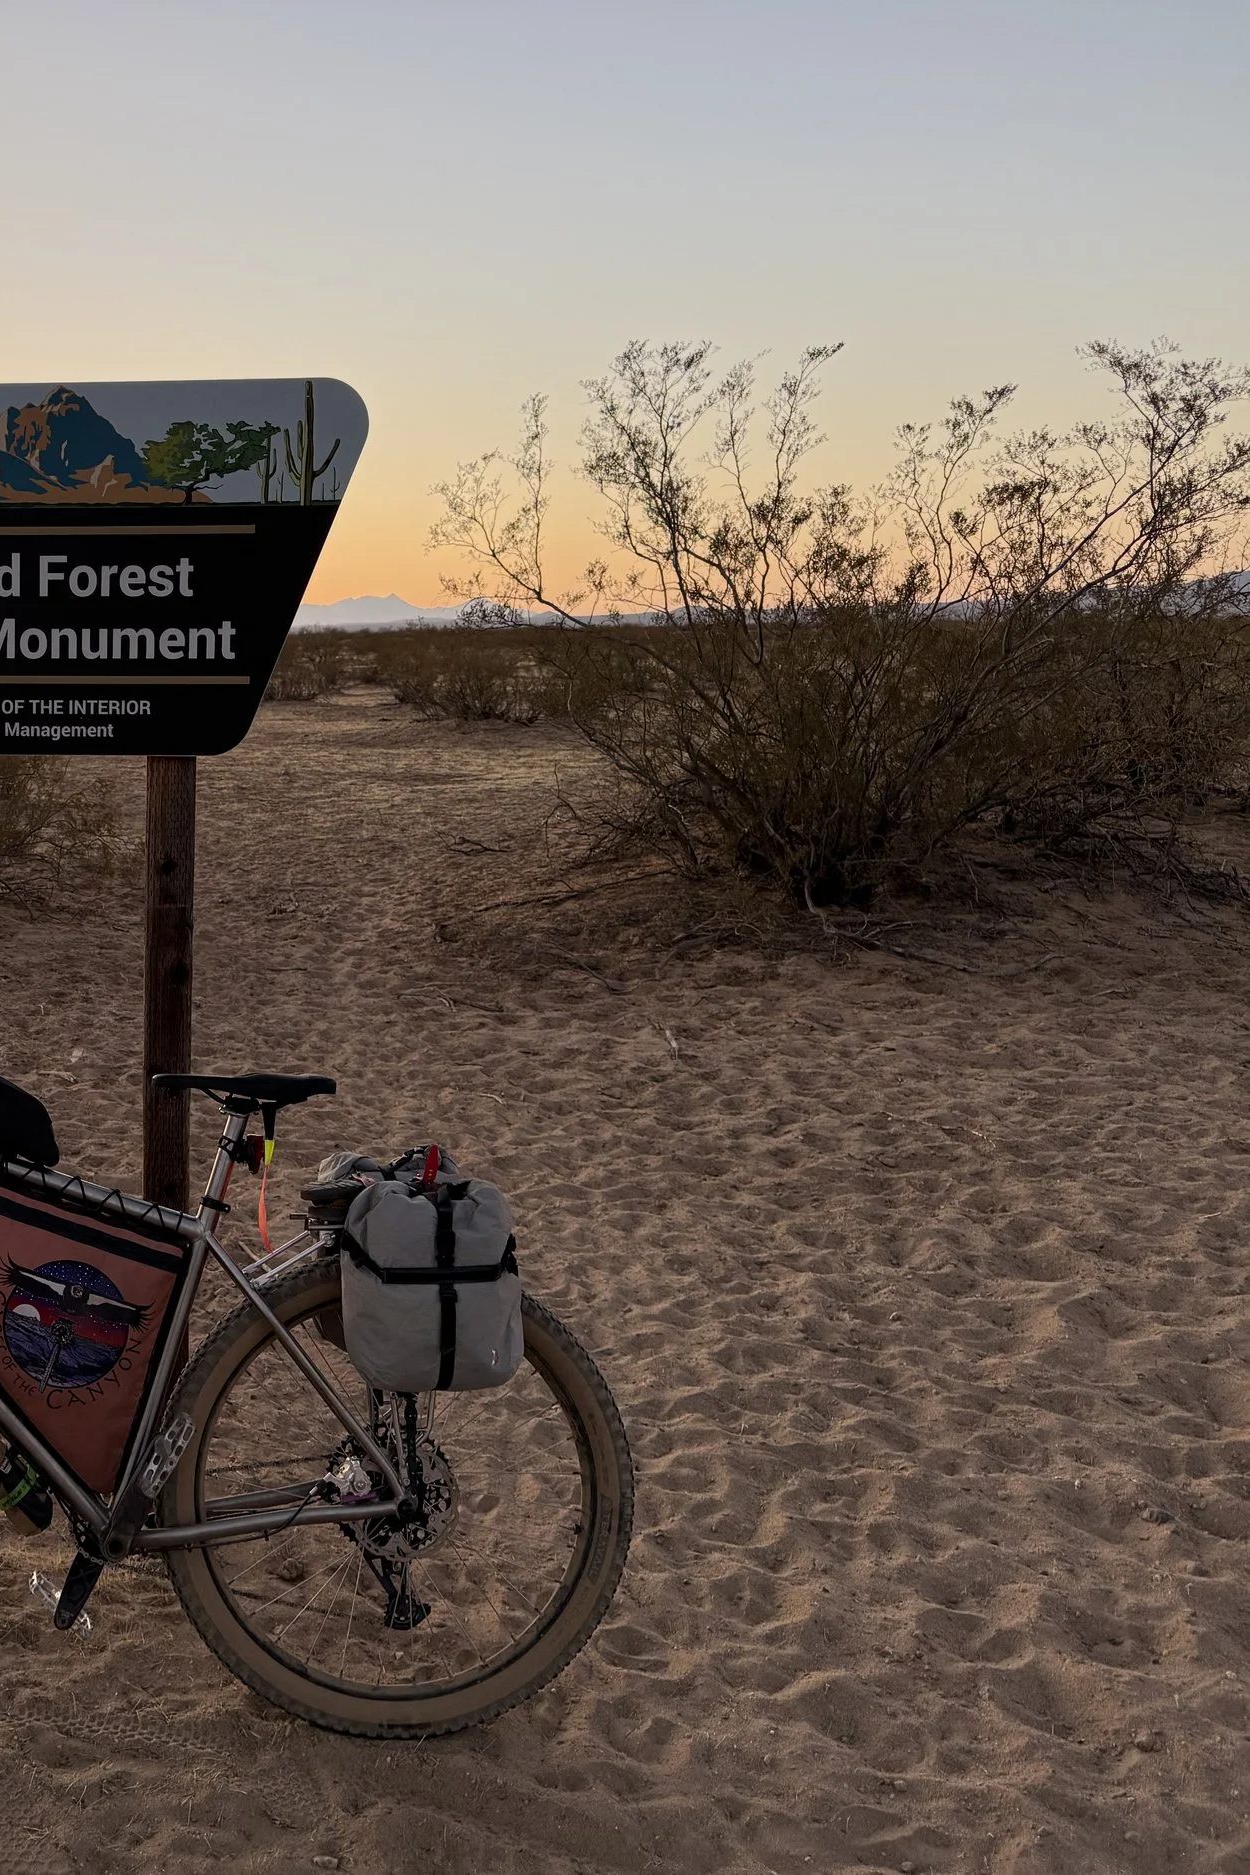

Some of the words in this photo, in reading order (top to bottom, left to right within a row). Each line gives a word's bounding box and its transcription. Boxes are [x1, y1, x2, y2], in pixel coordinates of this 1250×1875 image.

[38, 554, 194, 598] Forest
[1, 698, 25, 714] OF
[28, 699, 63, 714] THE
[68, 699, 152, 715] INTERIOR
[4, 722, 115, 741] Management
[2, 1355, 15, 1372] OF
[13, 1374, 38, 1397] THE
[46, 1337, 143, 1410] CANYON
